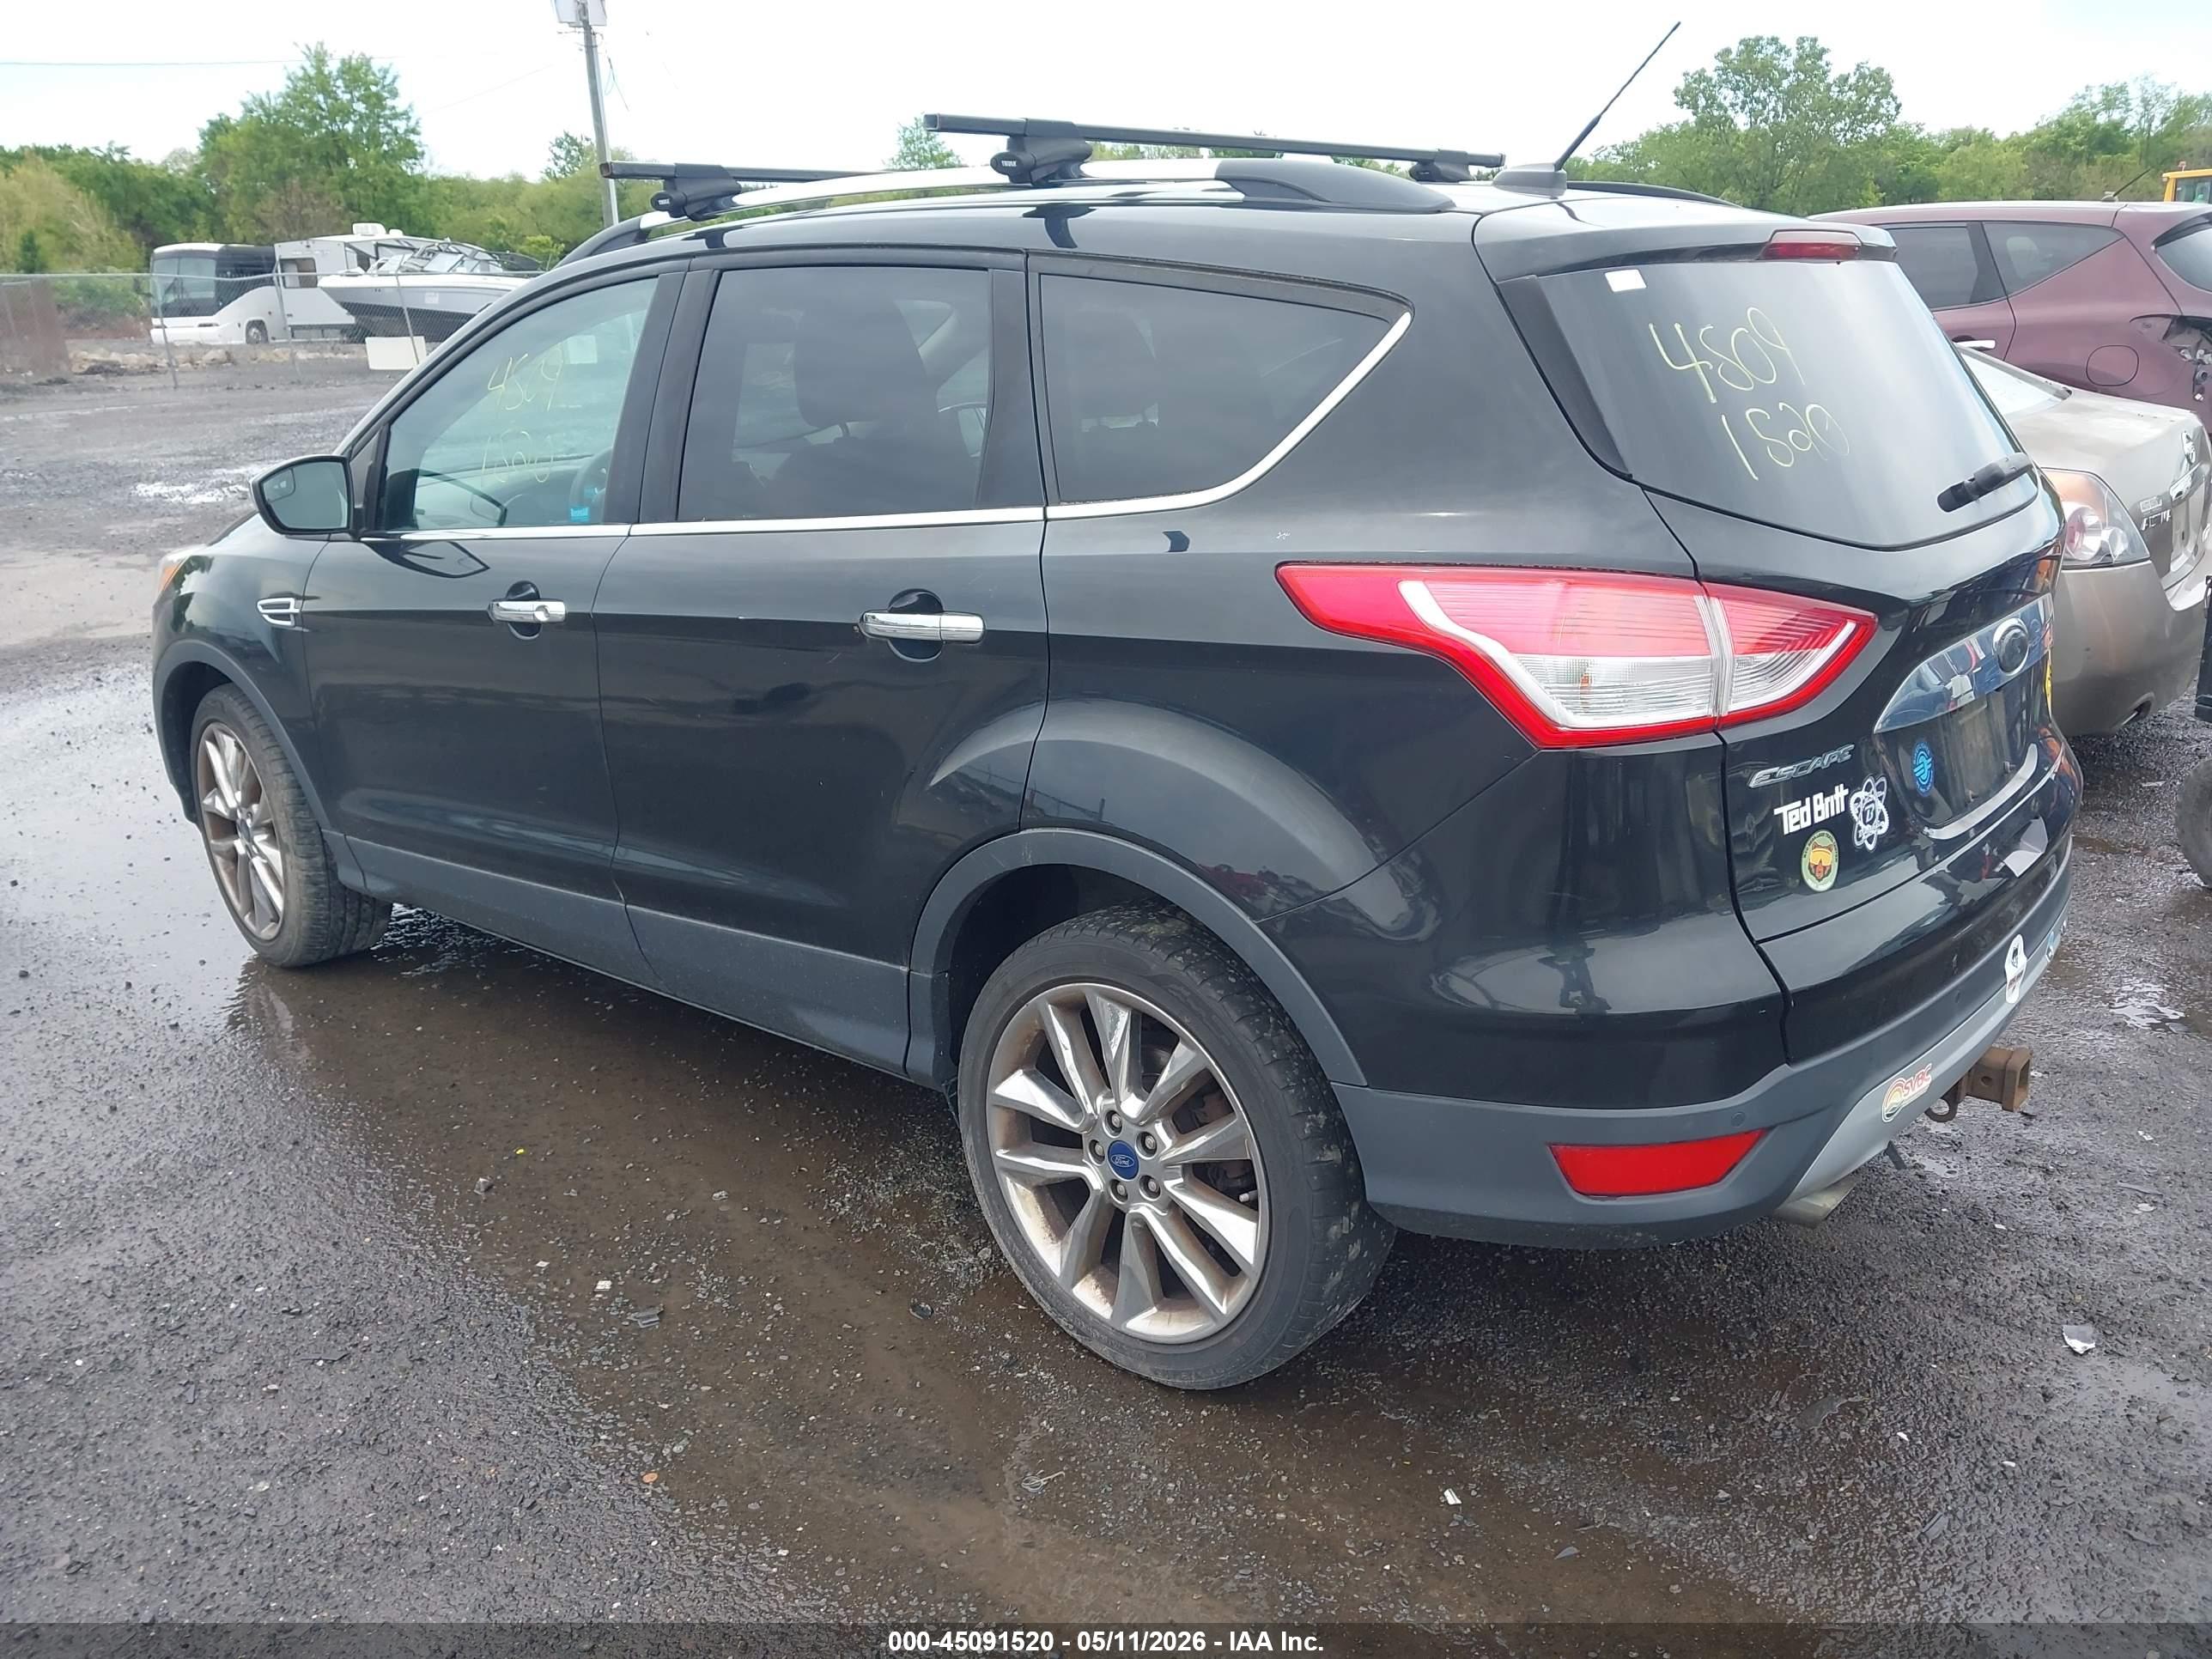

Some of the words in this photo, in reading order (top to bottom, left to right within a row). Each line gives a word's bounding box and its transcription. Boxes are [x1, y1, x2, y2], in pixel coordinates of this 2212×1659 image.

[1649, 307, 1805, 404] 4509
[1722, 402, 1850, 481] 1520
[1747, 744, 1855, 788] ESCAPE
[1773, 796, 1812, 836] Ted
[1813, 783, 1850, 824] Britt
